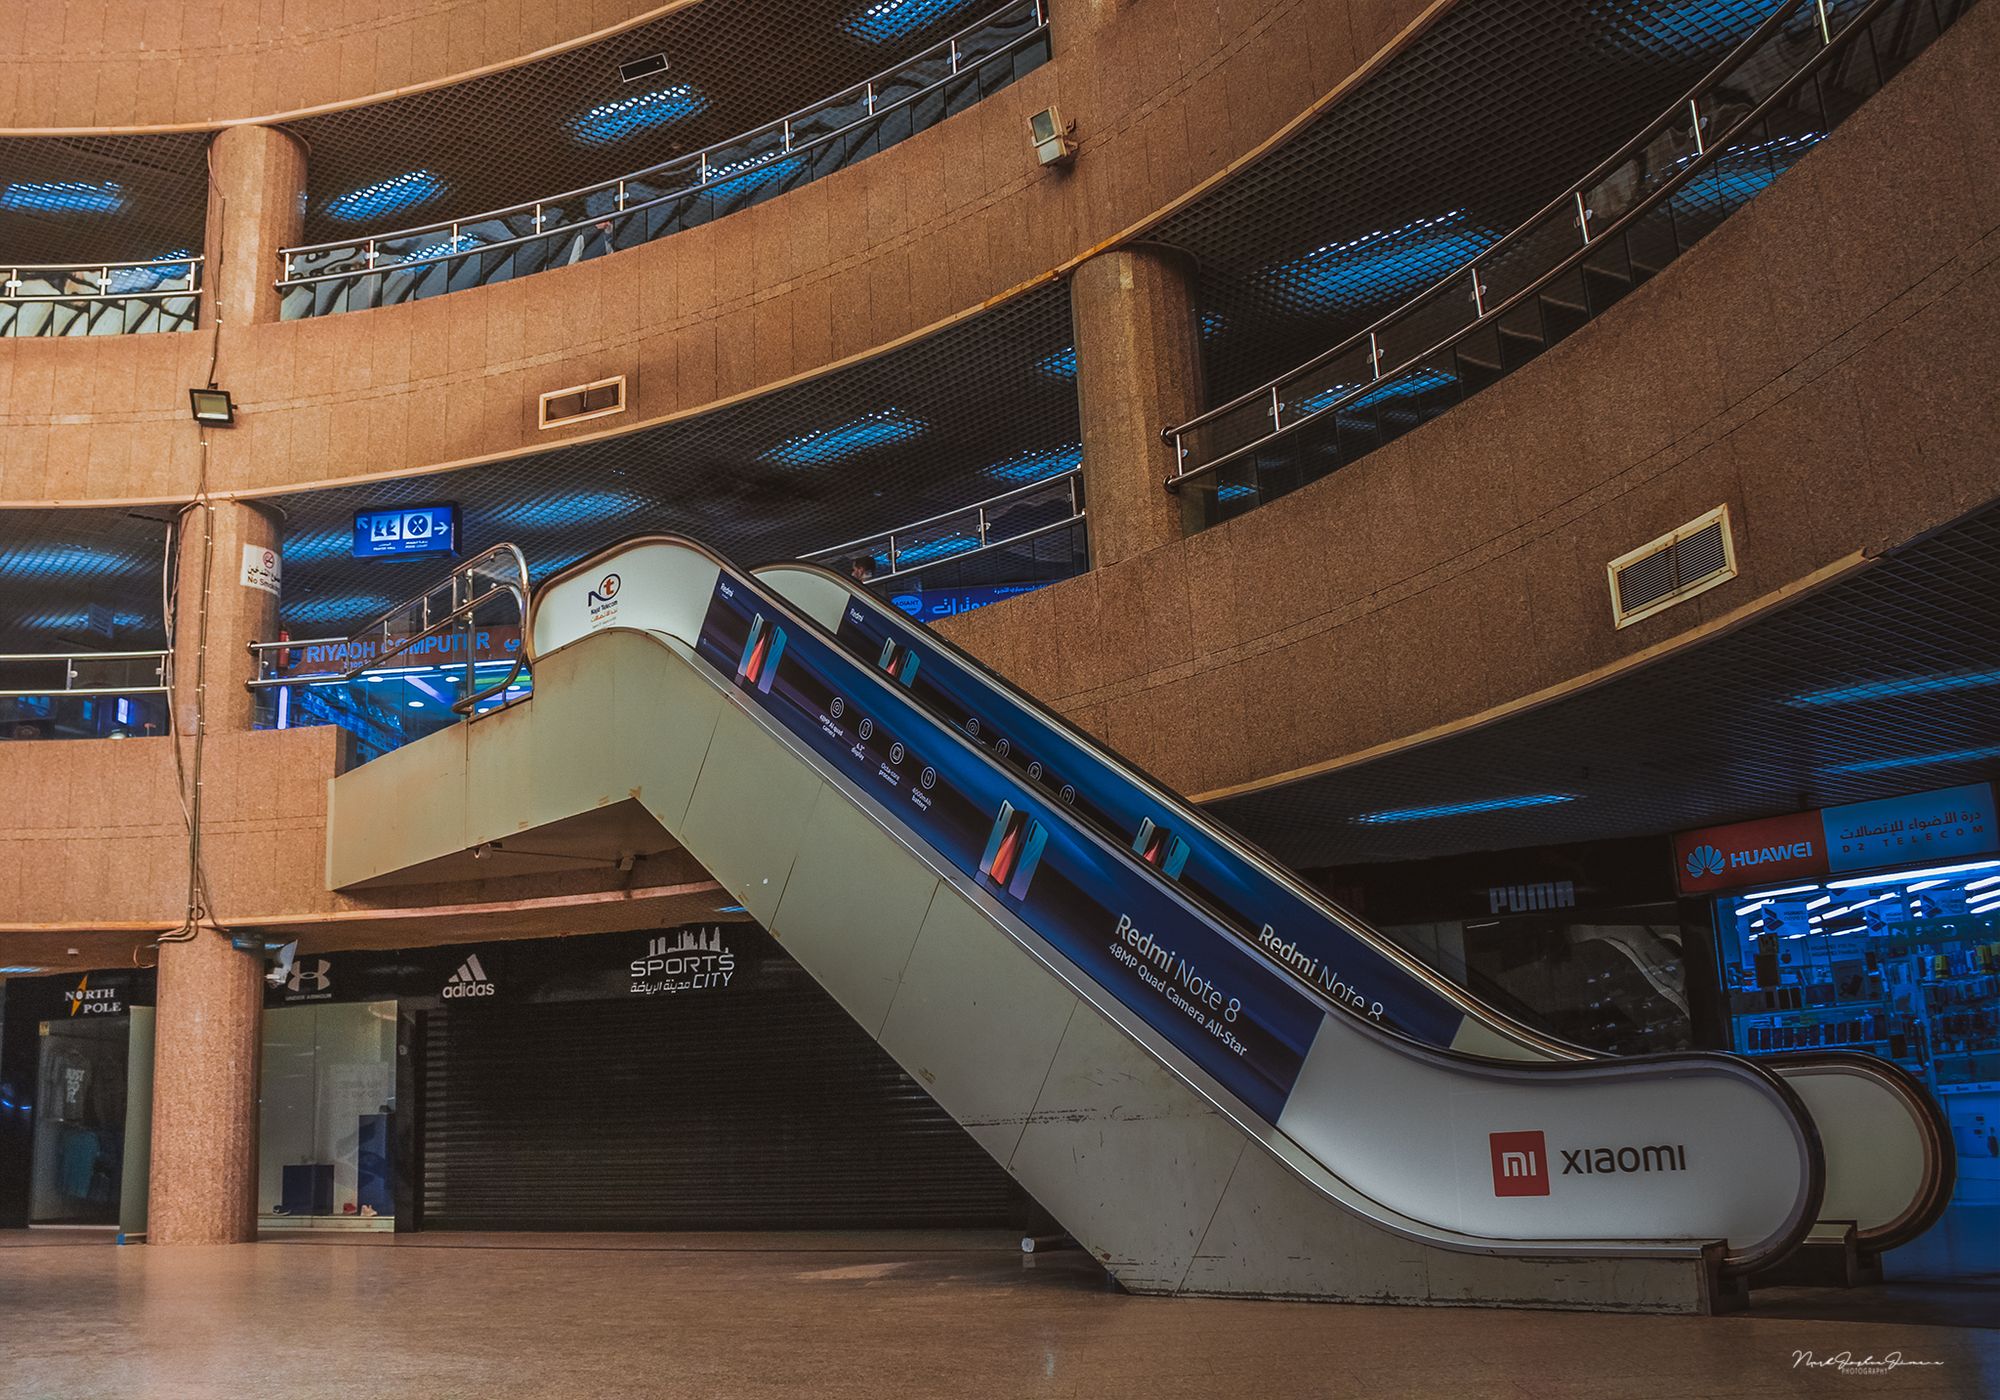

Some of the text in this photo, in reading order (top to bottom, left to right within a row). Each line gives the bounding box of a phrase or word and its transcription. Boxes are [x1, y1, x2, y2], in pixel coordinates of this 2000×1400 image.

[247, 576, 258, 585] No
[720, 582, 735, 598] Redmi
[894, 599, 920, 607] ADIANT
[850, 607, 864, 623] Redmi
[307, 641, 375, 664] RIYADH
[1842, 824, 1984, 853] D2 TELECOM
[1729, 841, 1813, 868] HUAWEI
[1488, 880, 1576, 914] PUMA
[630, 953, 735, 978] SPORTS
[1114, 913, 1241, 1023] Redmi Note 8
[1258, 922, 1320, 977] Redmi
[1317, 965, 1365, 1009] Note
[441, 981, 496, 999] adidas
[630, 978, 691, 995] مدينة الرياضة
[692, 971, 733, 989] CITY
[65, 987, 116, 1002] NORTH
[1108, 942, 1248, 1057] 48MP Quad Camera All-Star
[83, 1001, 122, 1014] POLE
[1560, 1144, 1687, 1175] xiaomi
